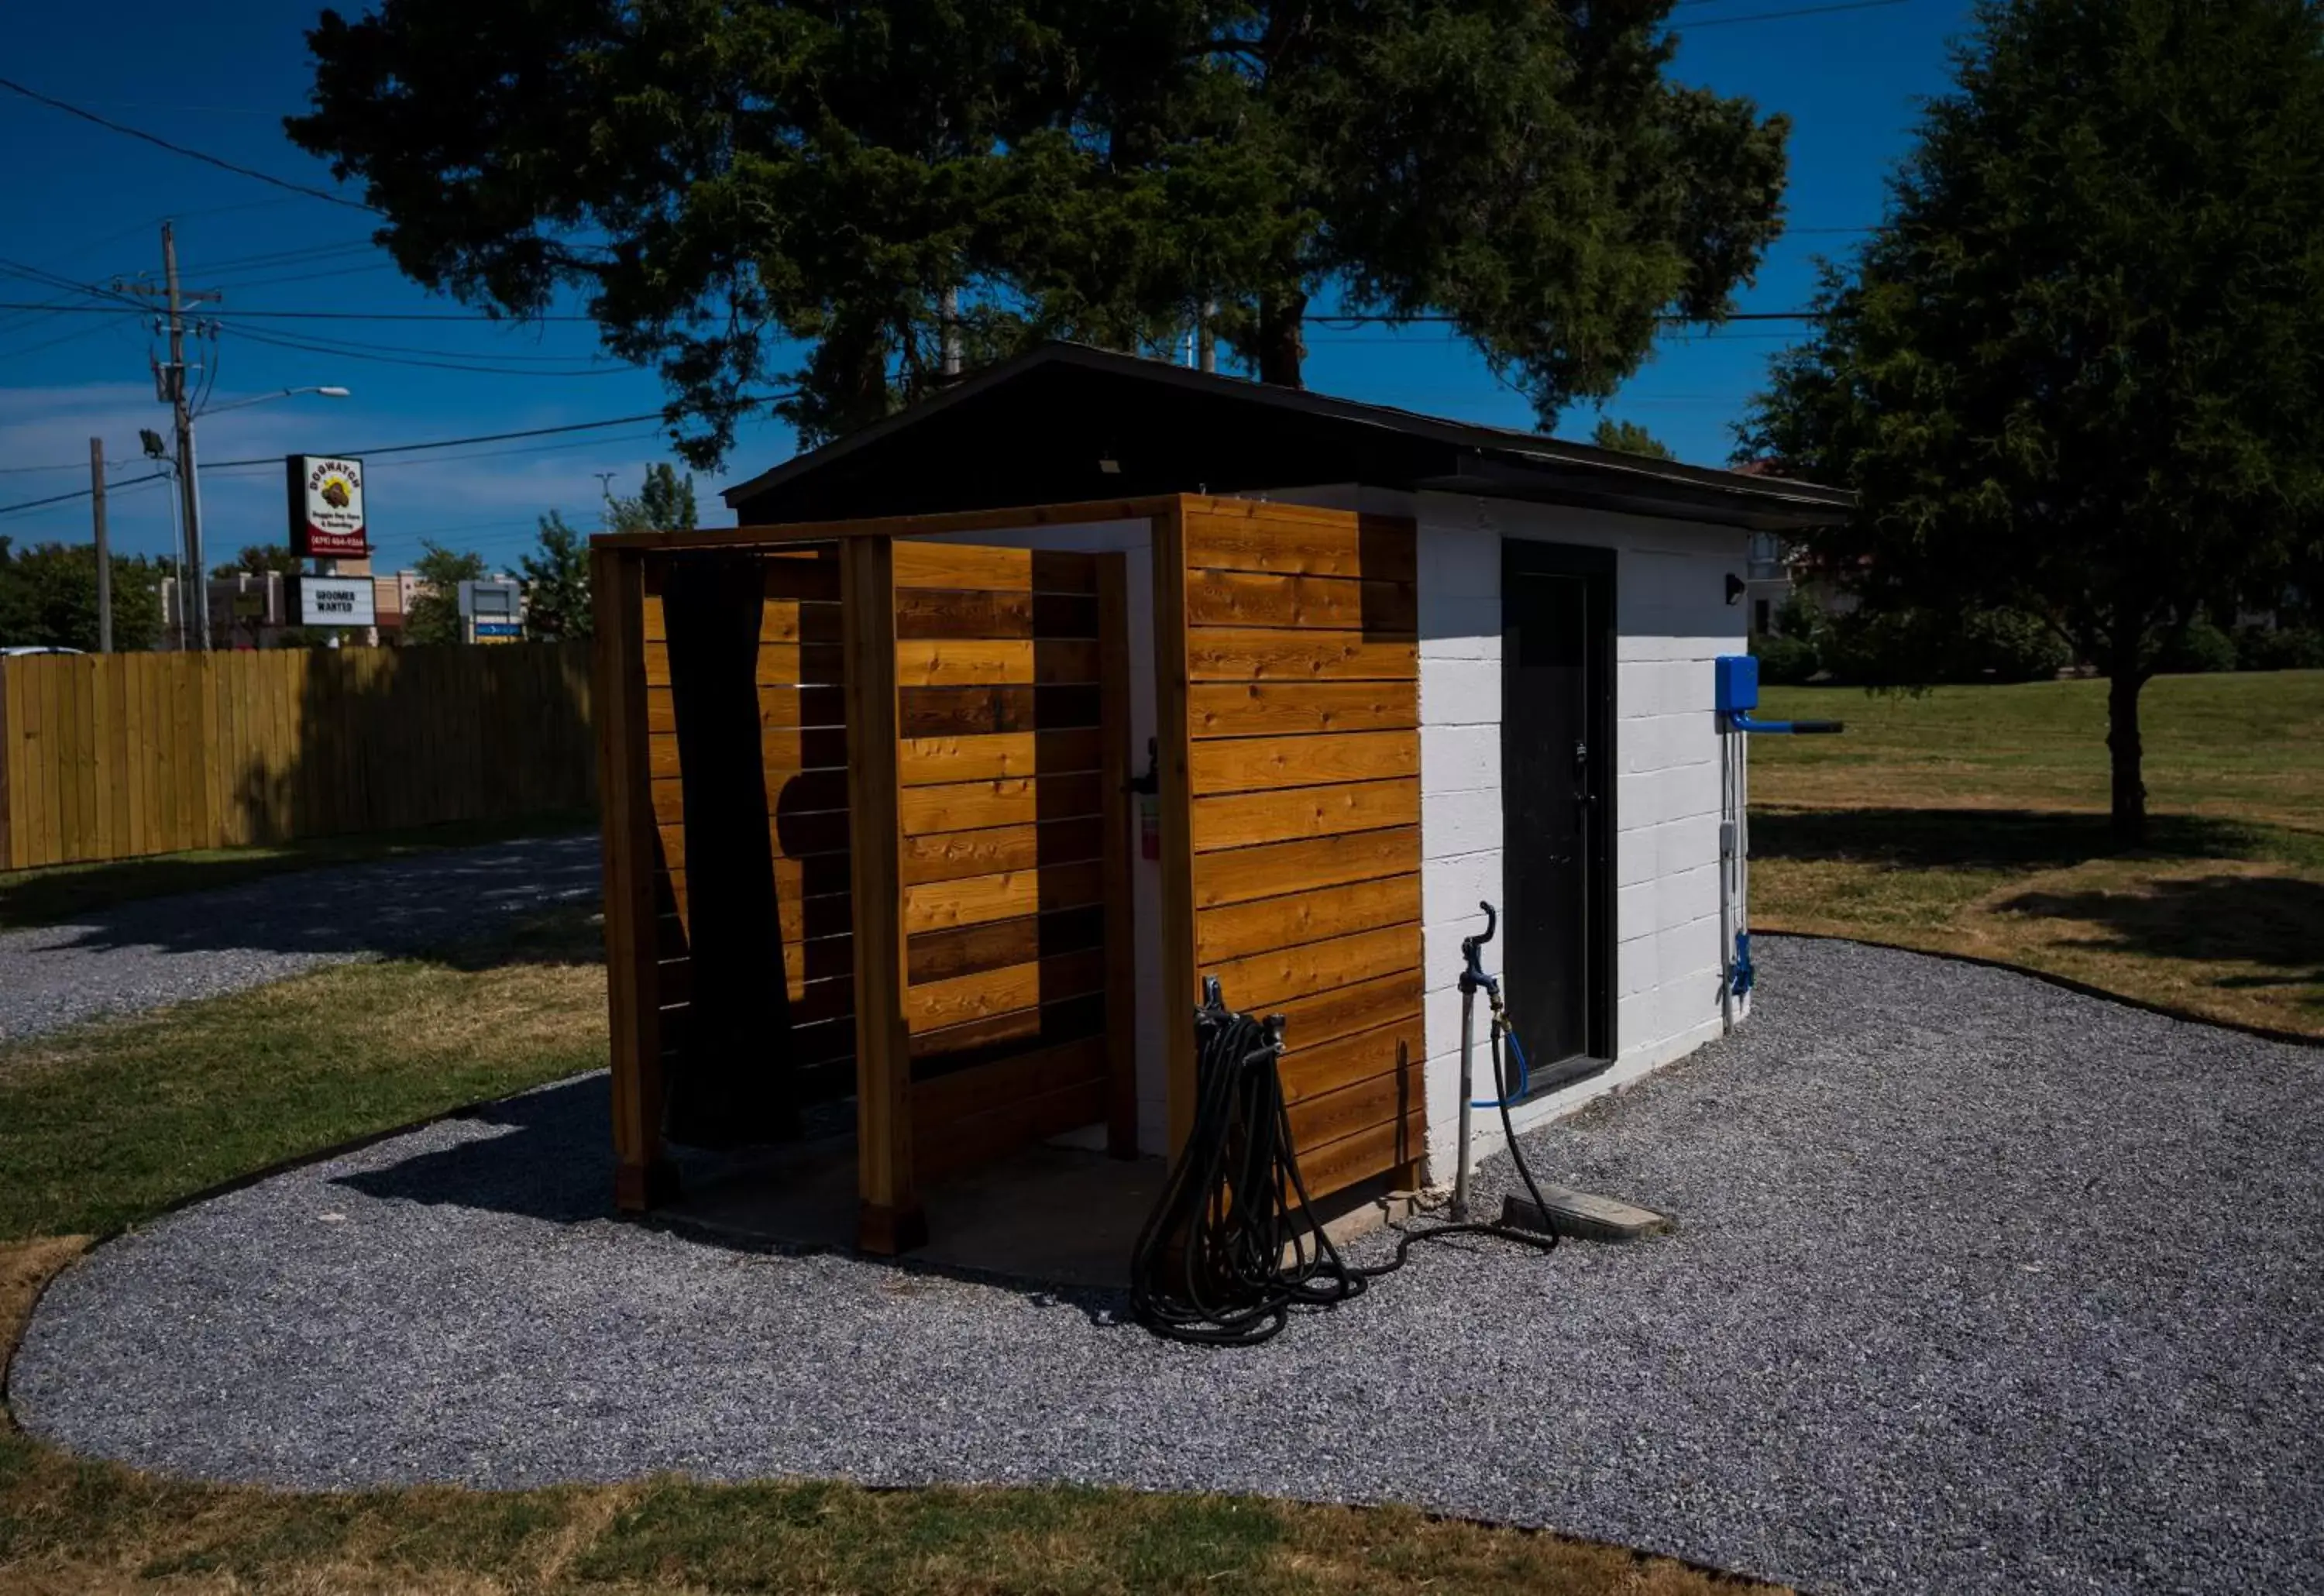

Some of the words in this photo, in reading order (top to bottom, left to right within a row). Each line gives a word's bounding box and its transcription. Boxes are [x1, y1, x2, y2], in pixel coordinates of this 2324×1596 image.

[310, 461, 360, 491] DOGWATCH
[315, 590, 355, 601] GROOMER
[317, 602, 352, 612] WANTED
